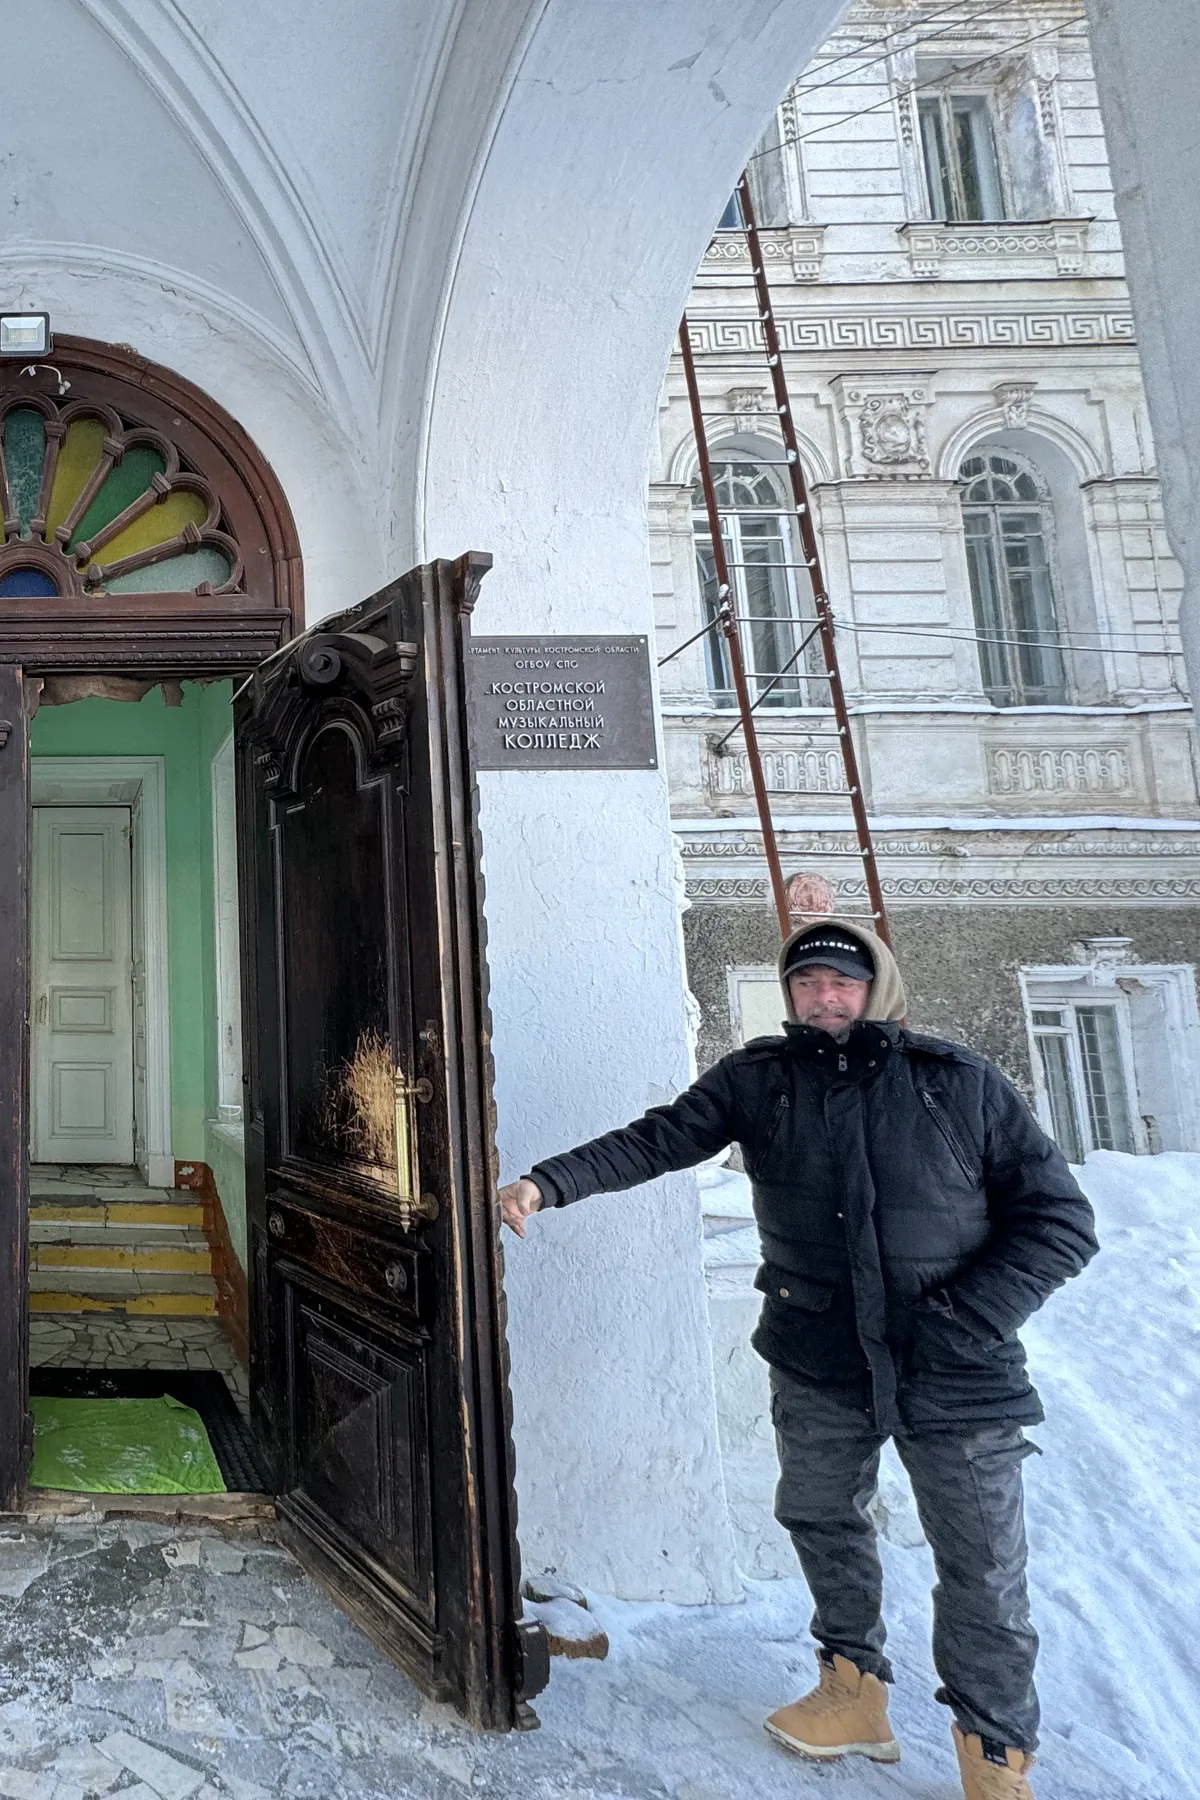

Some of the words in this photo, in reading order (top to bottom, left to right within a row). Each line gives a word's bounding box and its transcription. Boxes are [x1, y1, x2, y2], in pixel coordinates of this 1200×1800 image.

[544, 645, 600, 654] КОСТРОМСКОЙ
[605, 646, 639, 654] ОБЛАСТИ
[515, 660, 550, 669] ОГБОУ
[556, 660, 579, 669] СПО
[506, 697, 595, 711] ОБЛАСТНОЙ
[498, 714, 604, 729] МУЗЫКАЛЬНЫЙ
